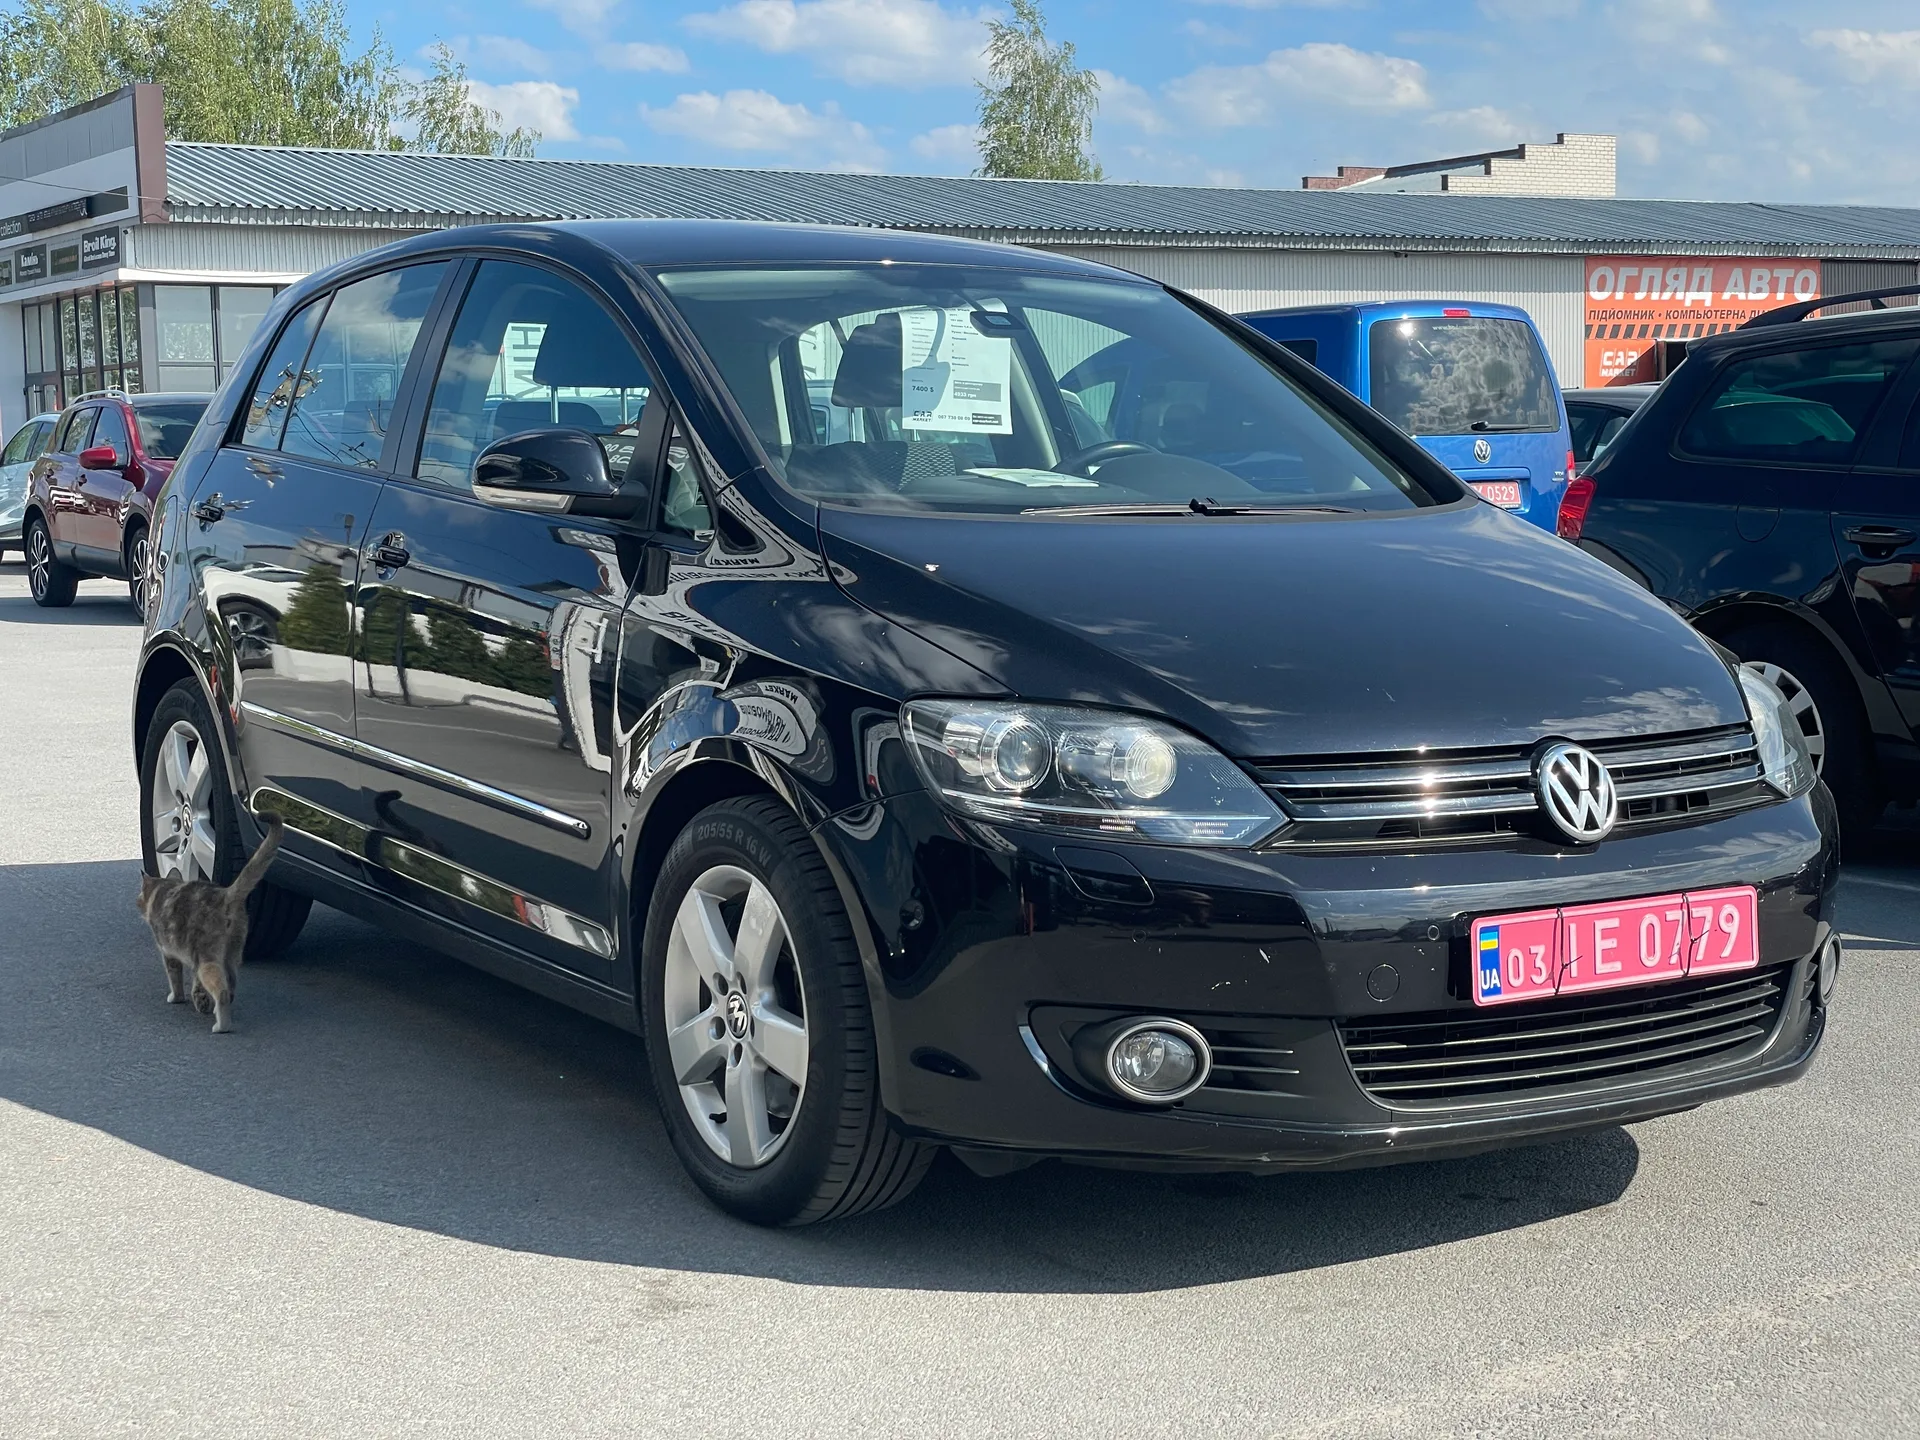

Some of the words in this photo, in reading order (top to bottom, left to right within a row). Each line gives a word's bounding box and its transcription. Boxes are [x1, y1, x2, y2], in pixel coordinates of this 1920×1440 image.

[83, 236, 99, 253] Broil
[100, 234, 116, 250] King
[1588, 266, 1714, 307] ОГЛЯД
[1721, 267, 1818, 302] АВТО
[1588, 308, 1655, 321] ПІДЙОМНИК
[1665, 309, 1746, 320] КОМПЬЮТЕРНА
[1600, 368, 1636, 377] MARKET
[1487, 485, 1516, 501] 0529
[698, 821, 734, 841] 205/55
[735, 828, 744, 845] R
[746, 835, 758, 855] 16
[1506, 944, 1548, 987] 03
[1568, 917, 1622, 978] IE
[1638, 903, 1741, 968] 0779
[1480, 968, 1501, 990] UA
